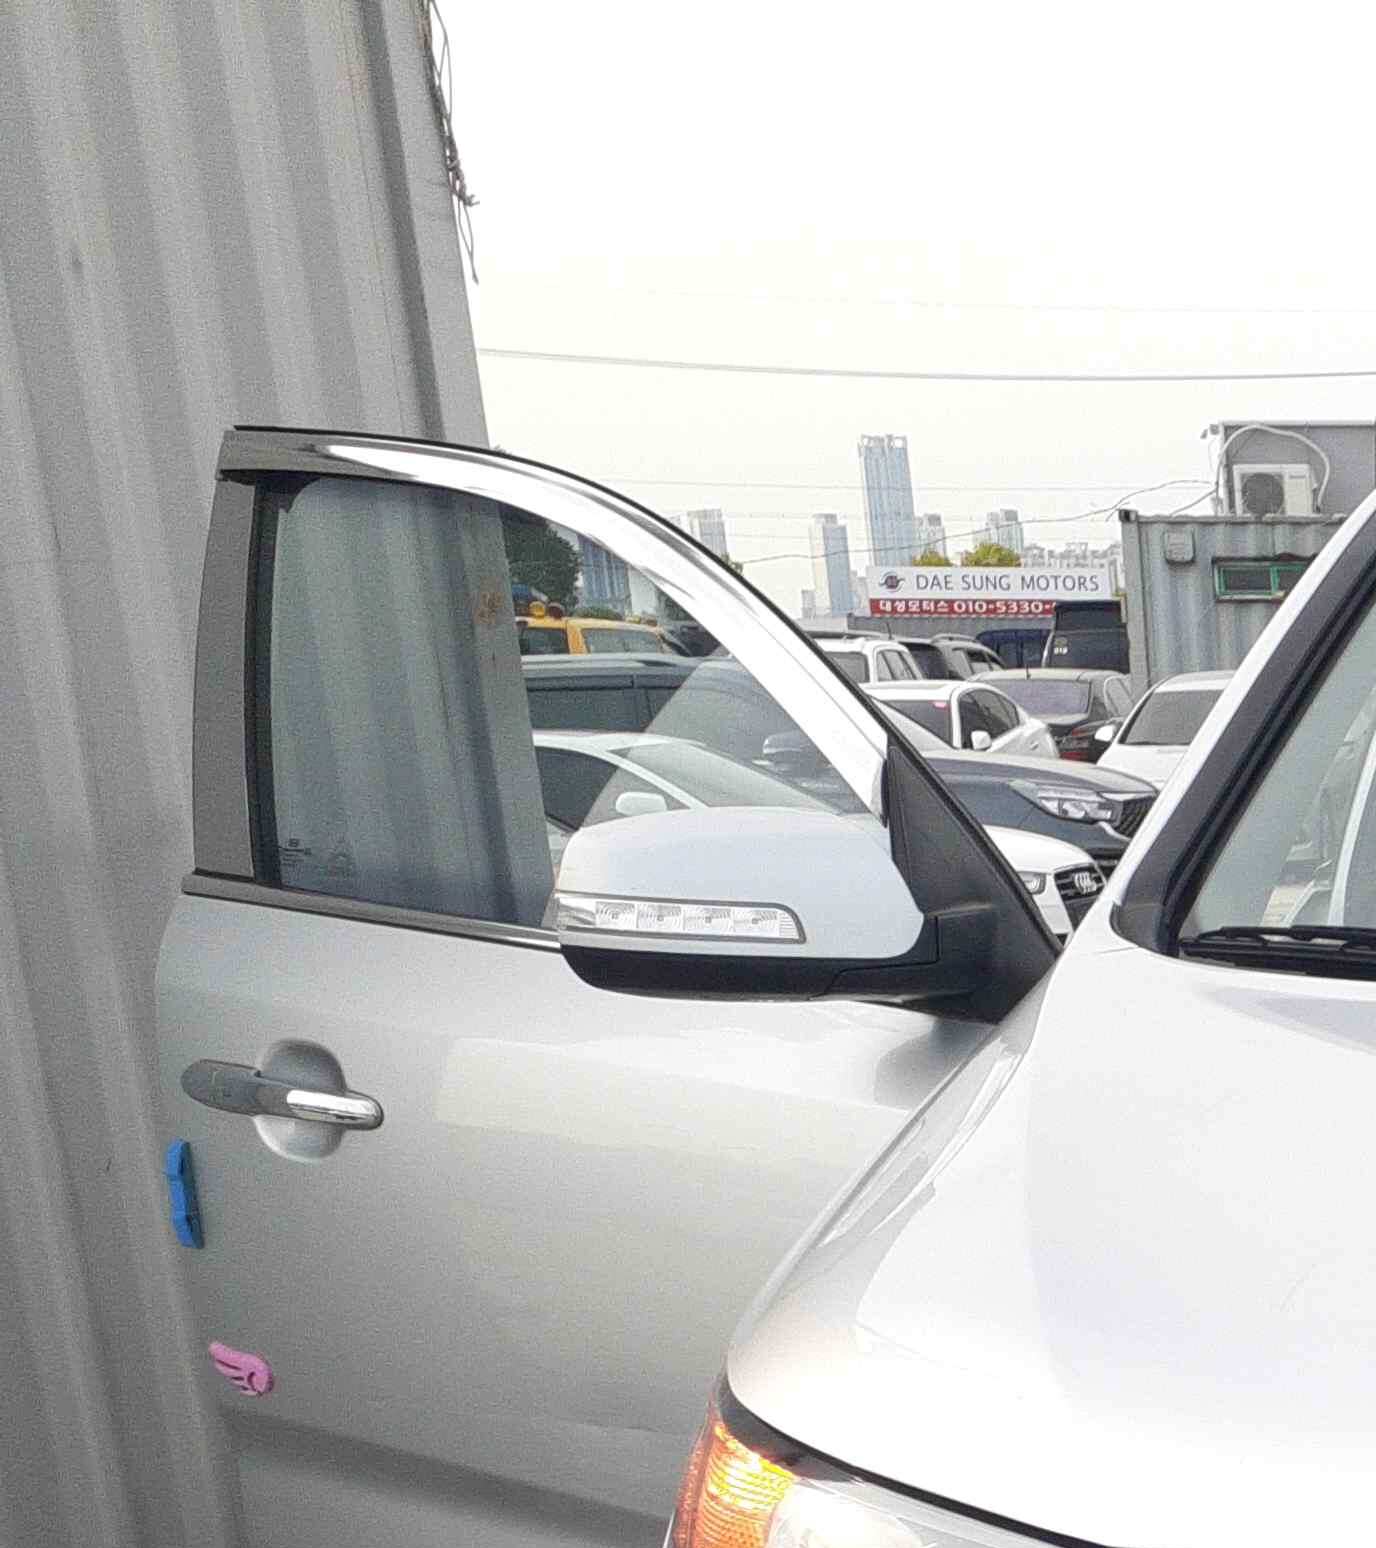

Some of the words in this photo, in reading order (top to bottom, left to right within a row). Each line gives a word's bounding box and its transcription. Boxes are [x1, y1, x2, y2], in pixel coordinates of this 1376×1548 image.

[915, 574, 953, 591] DAE
[961, 574, 1011, 592] SUNG
[1020, 574, 1100, 592] MOTORS
[879, 600, 950, 613] 대성모터스
[953, 600, 1057, 613] 010-5330-
